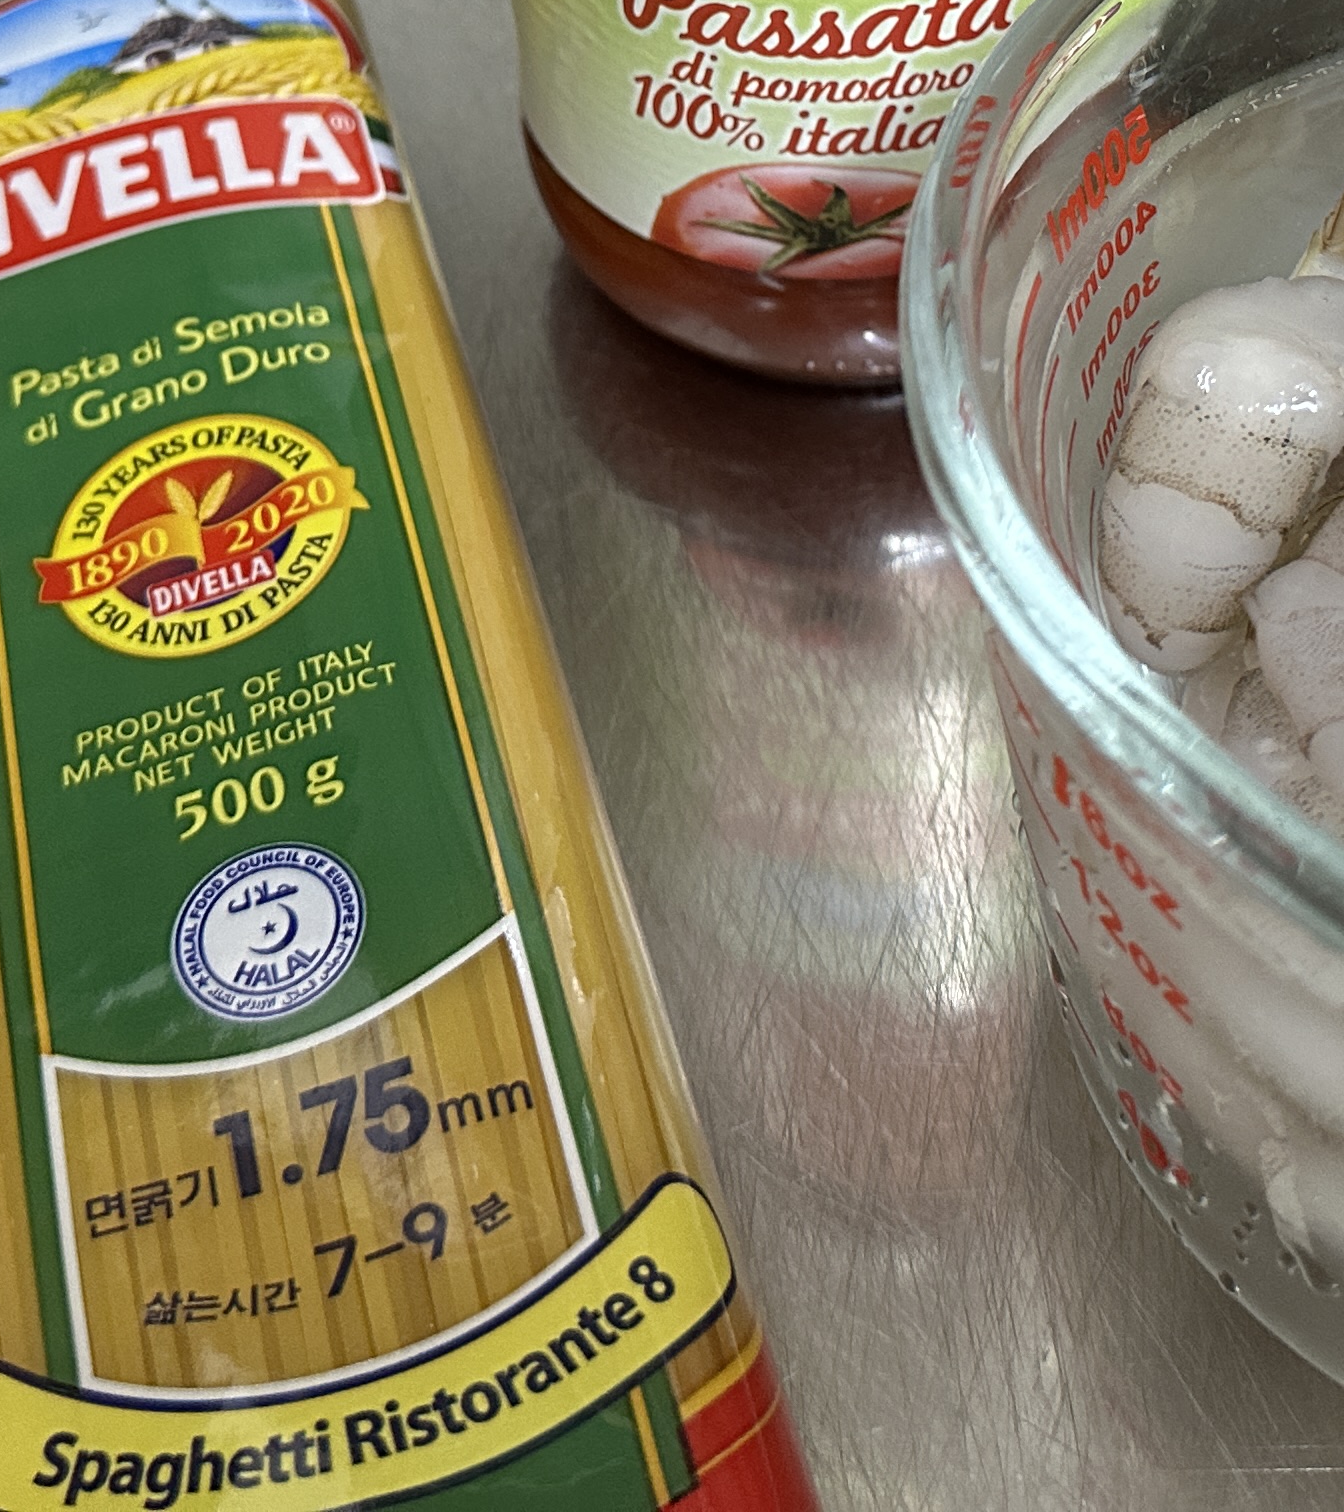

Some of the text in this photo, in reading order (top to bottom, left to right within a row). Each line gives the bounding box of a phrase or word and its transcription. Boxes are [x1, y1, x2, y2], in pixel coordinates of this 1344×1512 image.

[633, 74, 765, 152] 100%
[779, 107, 945, 155] italia
[672, 51, 975, 107] di pomodoro
[11, 302, 330, 407] Pasta di Semola
[25, 341, 330, 445] di Grano Duro
[66, 476, 335, 593] 1890 2020
[73, 425, 311, 540] 130 YEARS OF PASTA
[88, 532, 334, 645] 130 ANNI DI PASTA
[155, 555, 273, 613] DIVELLA
[62, 663, 397, 787] MACARONI PRODUCT
[76, 641, 375, 754] PRODUCT OF ITALY
[134, 707, 338, 793] NET WEIGHT
[175, 755, 345, 841] 500 g
[184, 850, 355, 977] HALAL FOOD COUNCIL OF EUROPE
[228, 880, 299, 913] حلال
[233, 948, 321, 987] HALAL
[83, 1169, 221, 1240] 면굵기
[142, 1278, 302, 1328] 삶는시간
[471, 1193, 514, 1234] 분
[33, 1254, 678, 1511] Spaghetti Ristorante 8
